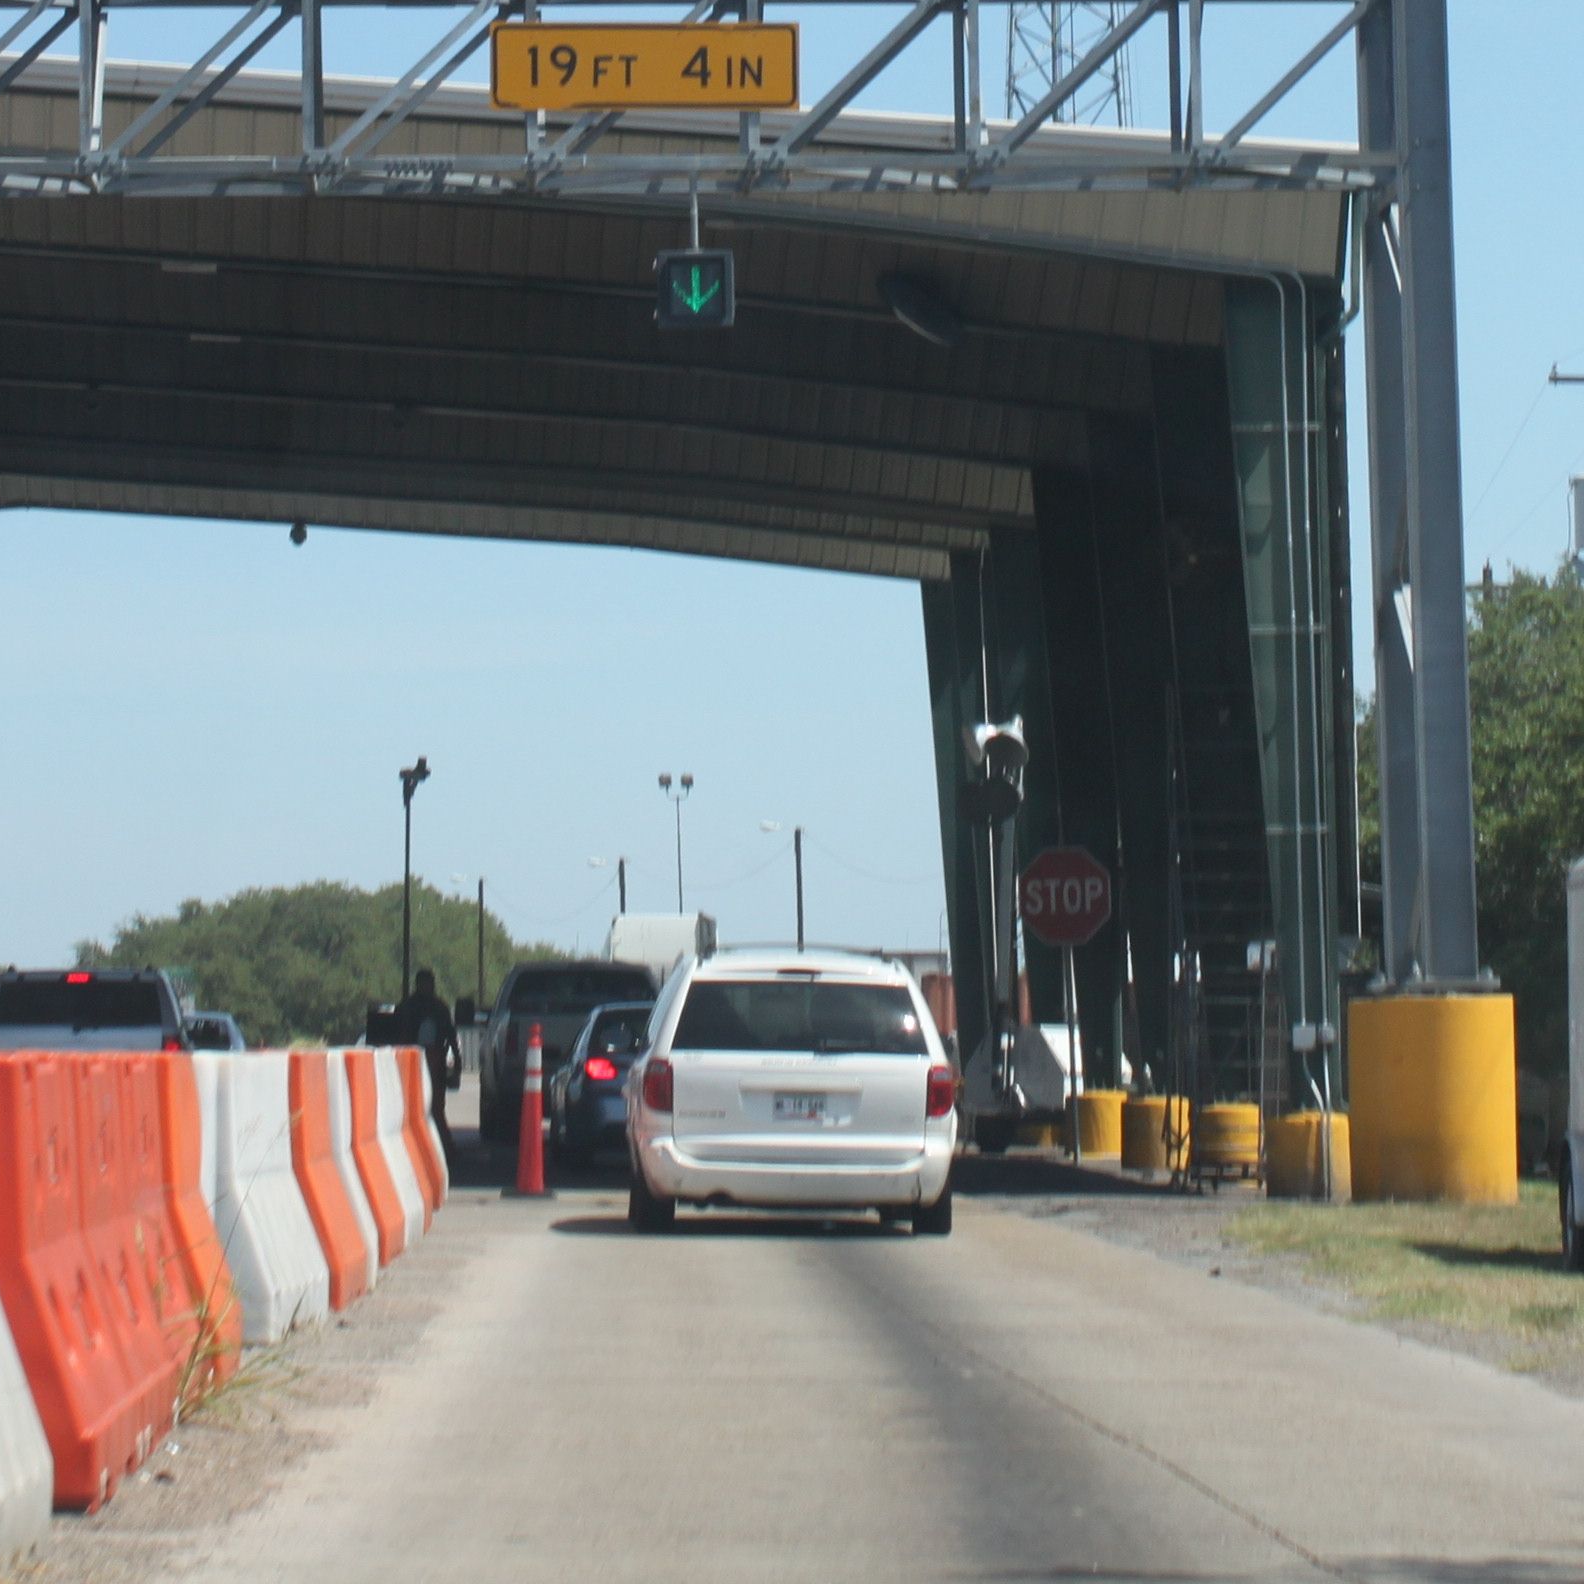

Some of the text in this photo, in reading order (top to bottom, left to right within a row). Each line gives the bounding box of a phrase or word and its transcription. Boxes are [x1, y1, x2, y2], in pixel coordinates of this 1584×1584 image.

[528, 45, 763, 88] 19 FT 4 IN
[1025, 876, 1103, 914] STOP
